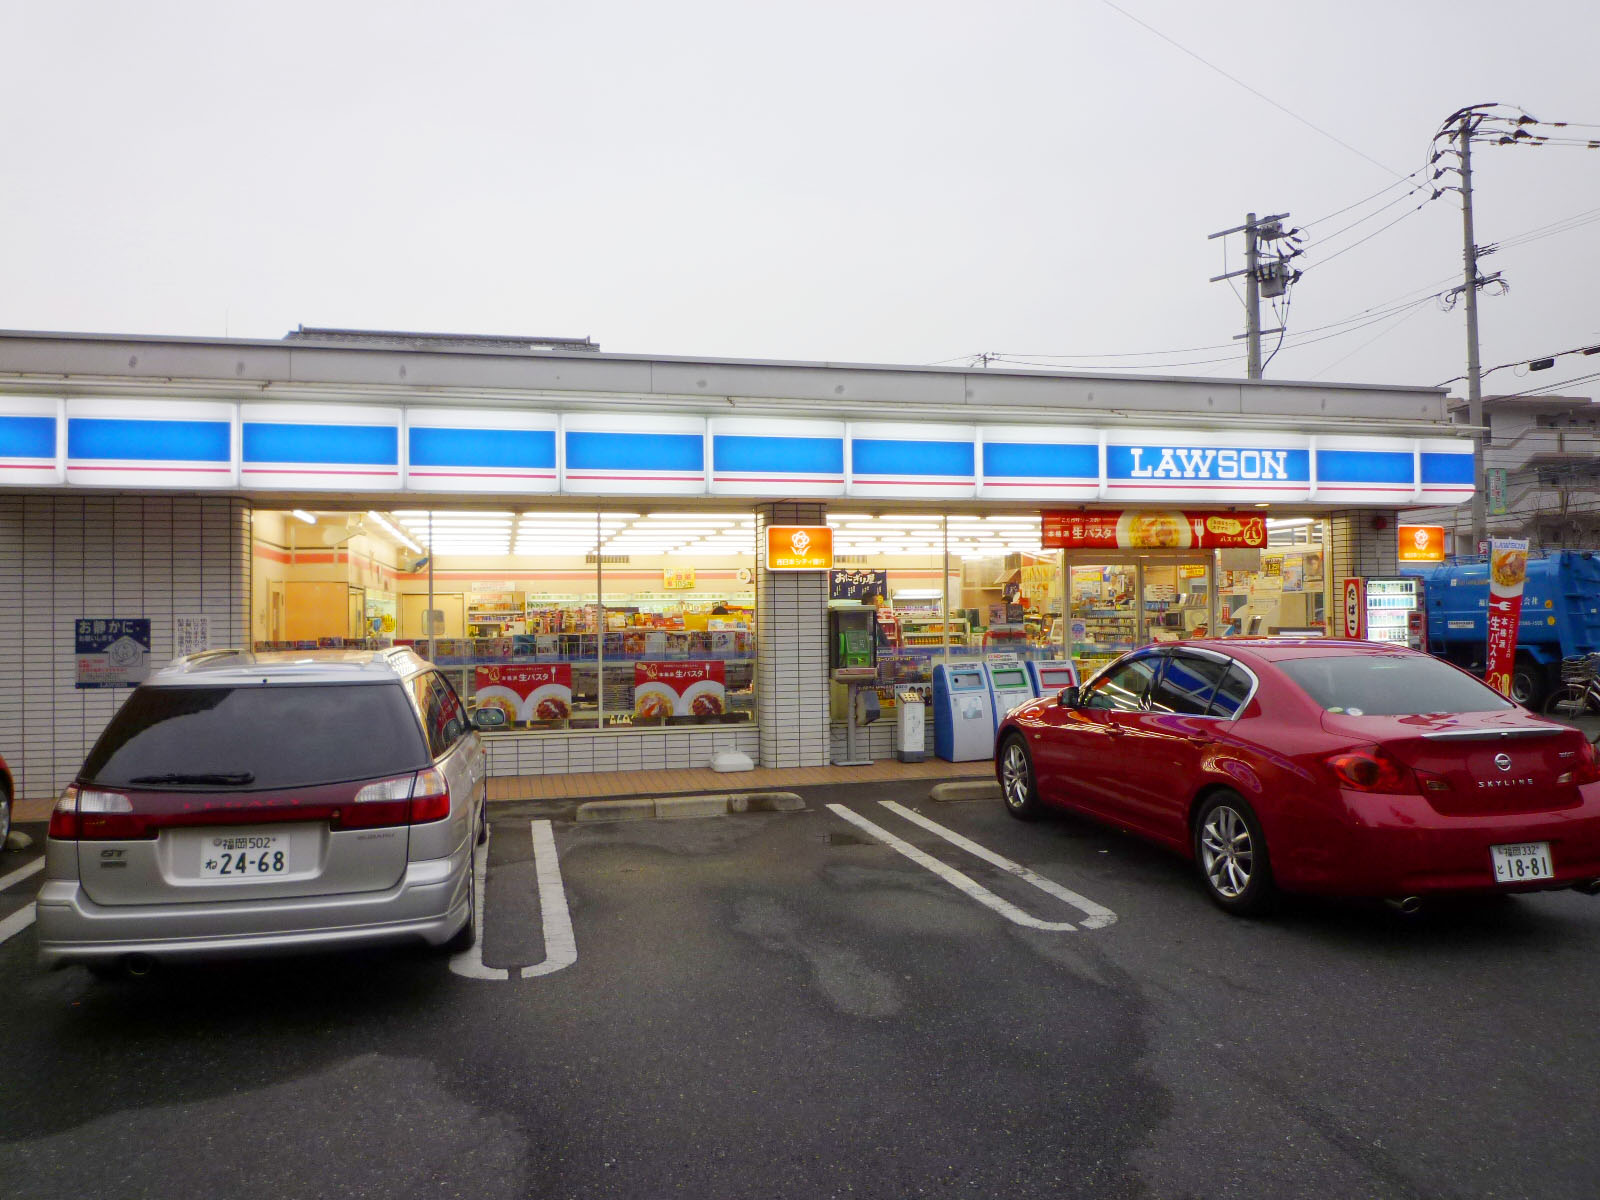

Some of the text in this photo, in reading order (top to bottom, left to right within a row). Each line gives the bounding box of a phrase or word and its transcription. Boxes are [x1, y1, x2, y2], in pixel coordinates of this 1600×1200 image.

[1130, 448, 1288, 480] LAWSON
[1072, 528, 1112, 539] 生パスタ
[776, 558, 825, 566] 西日本シティ銀行
[835, 573, 876, 585] おにぎり屋
[1348, 588, 1357, 631] たばこ
[79, 620, 134, 634] お静かに
[1499, 617, 1508, 648] 本格派
[1489, 616, 1501, 671] 生パスタ
[519, 673, 549, 682] 生パスタ
[675, 670, 704, 678] 生パスタ
[1478, 778, 1534, 788] SKYLINE
[205, 851, 285, 875] ね 24-68
[1497, 856, 1548, 878] と 18-81
